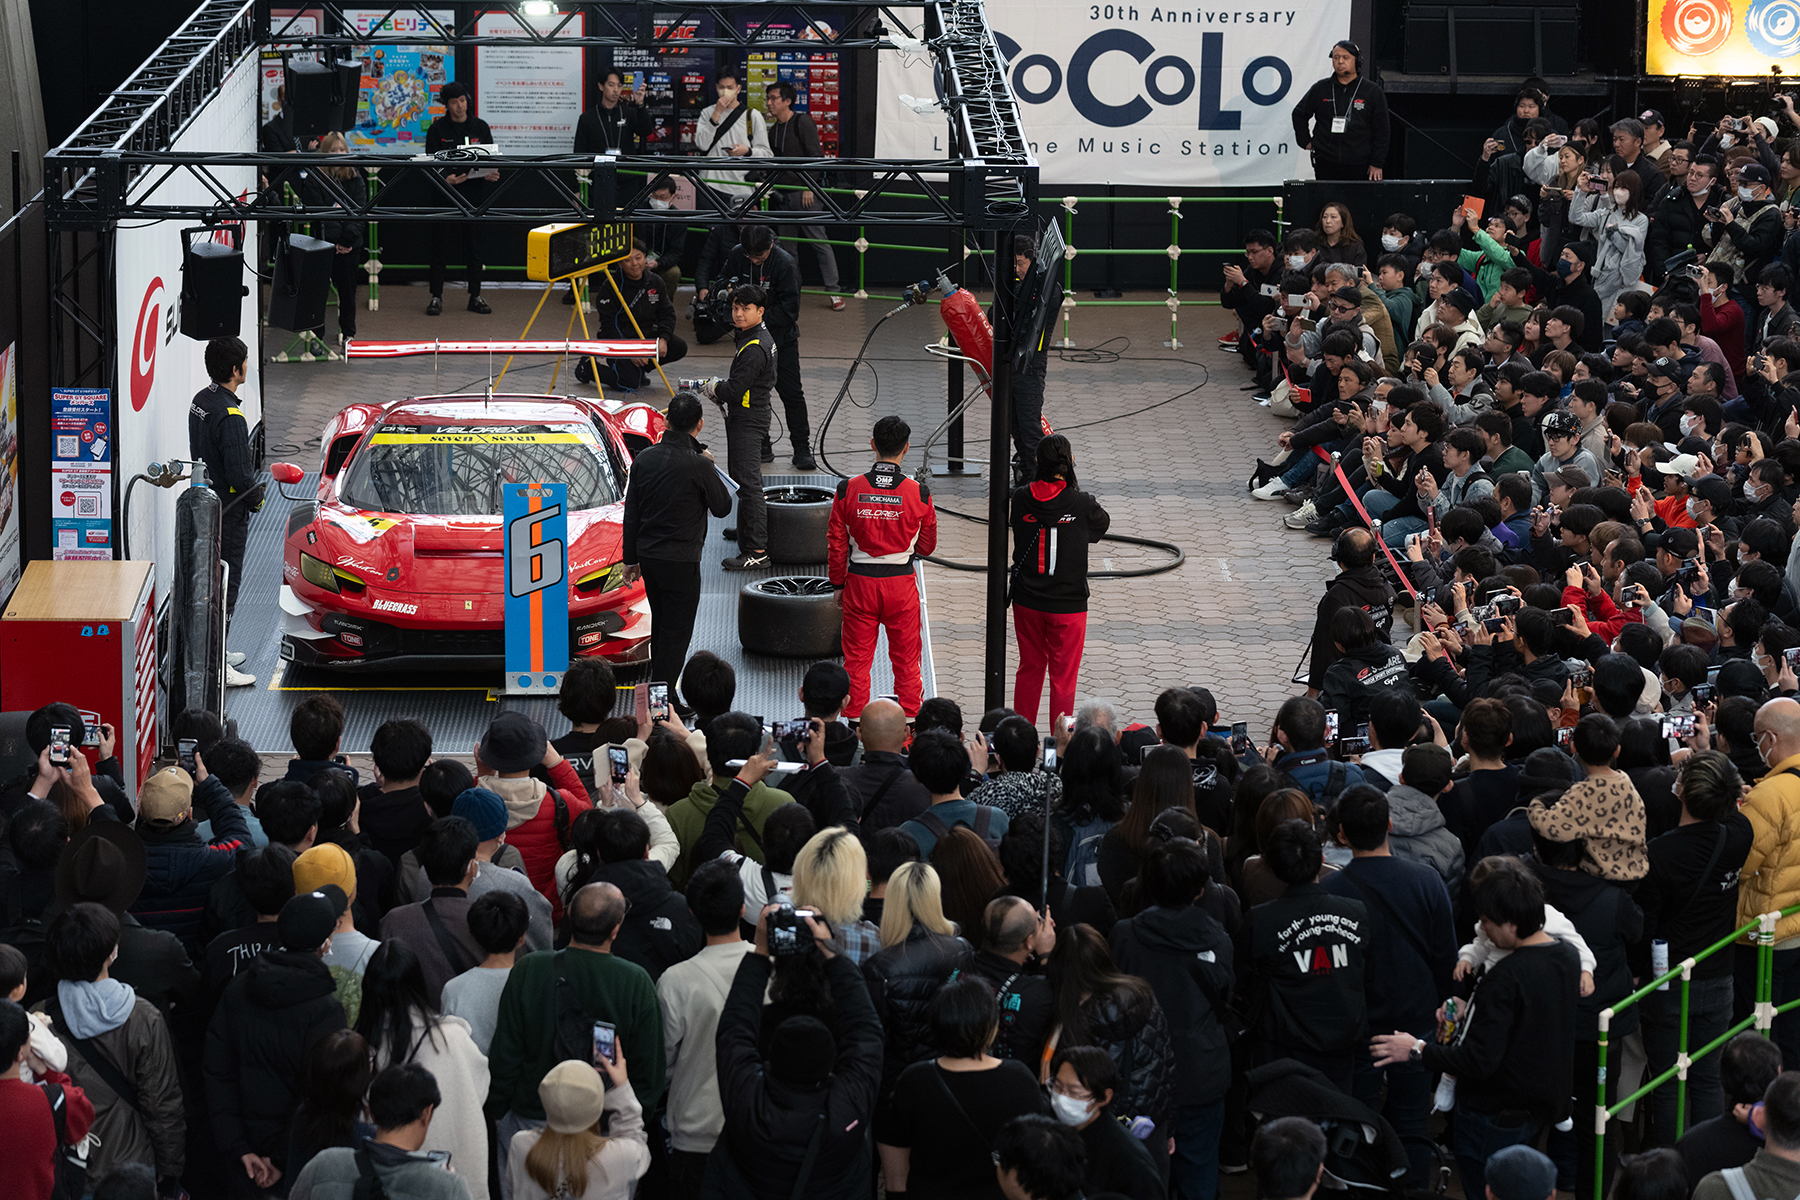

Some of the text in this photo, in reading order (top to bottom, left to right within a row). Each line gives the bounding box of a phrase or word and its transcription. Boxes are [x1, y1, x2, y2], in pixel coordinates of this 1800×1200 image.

[1090, 5, 1296, 26] 30th Anniversary
[357, 18, 431, 31] こどもビリテ
[646, 25, 698, 39] USIC
[1078, 138, 1289, 156] Music Station
[83, 393, 107, 401] SQUARE
[436, 425, 522, 433] VELOREX
[857, 509, 904, 517] VELOREX
[509, 503, 563, 598] 6
[372, 599, 418, 615] BLUEGRASS
[343, 634, 361, 645] TONE
[581, 633, 600, 644] TONE
[1277, 926, 1293, 941] for
[1308, 914, 1340, 926] young
[1340, 917, 1359, 931] and
[1293, 943, 1348, 973] VAN
